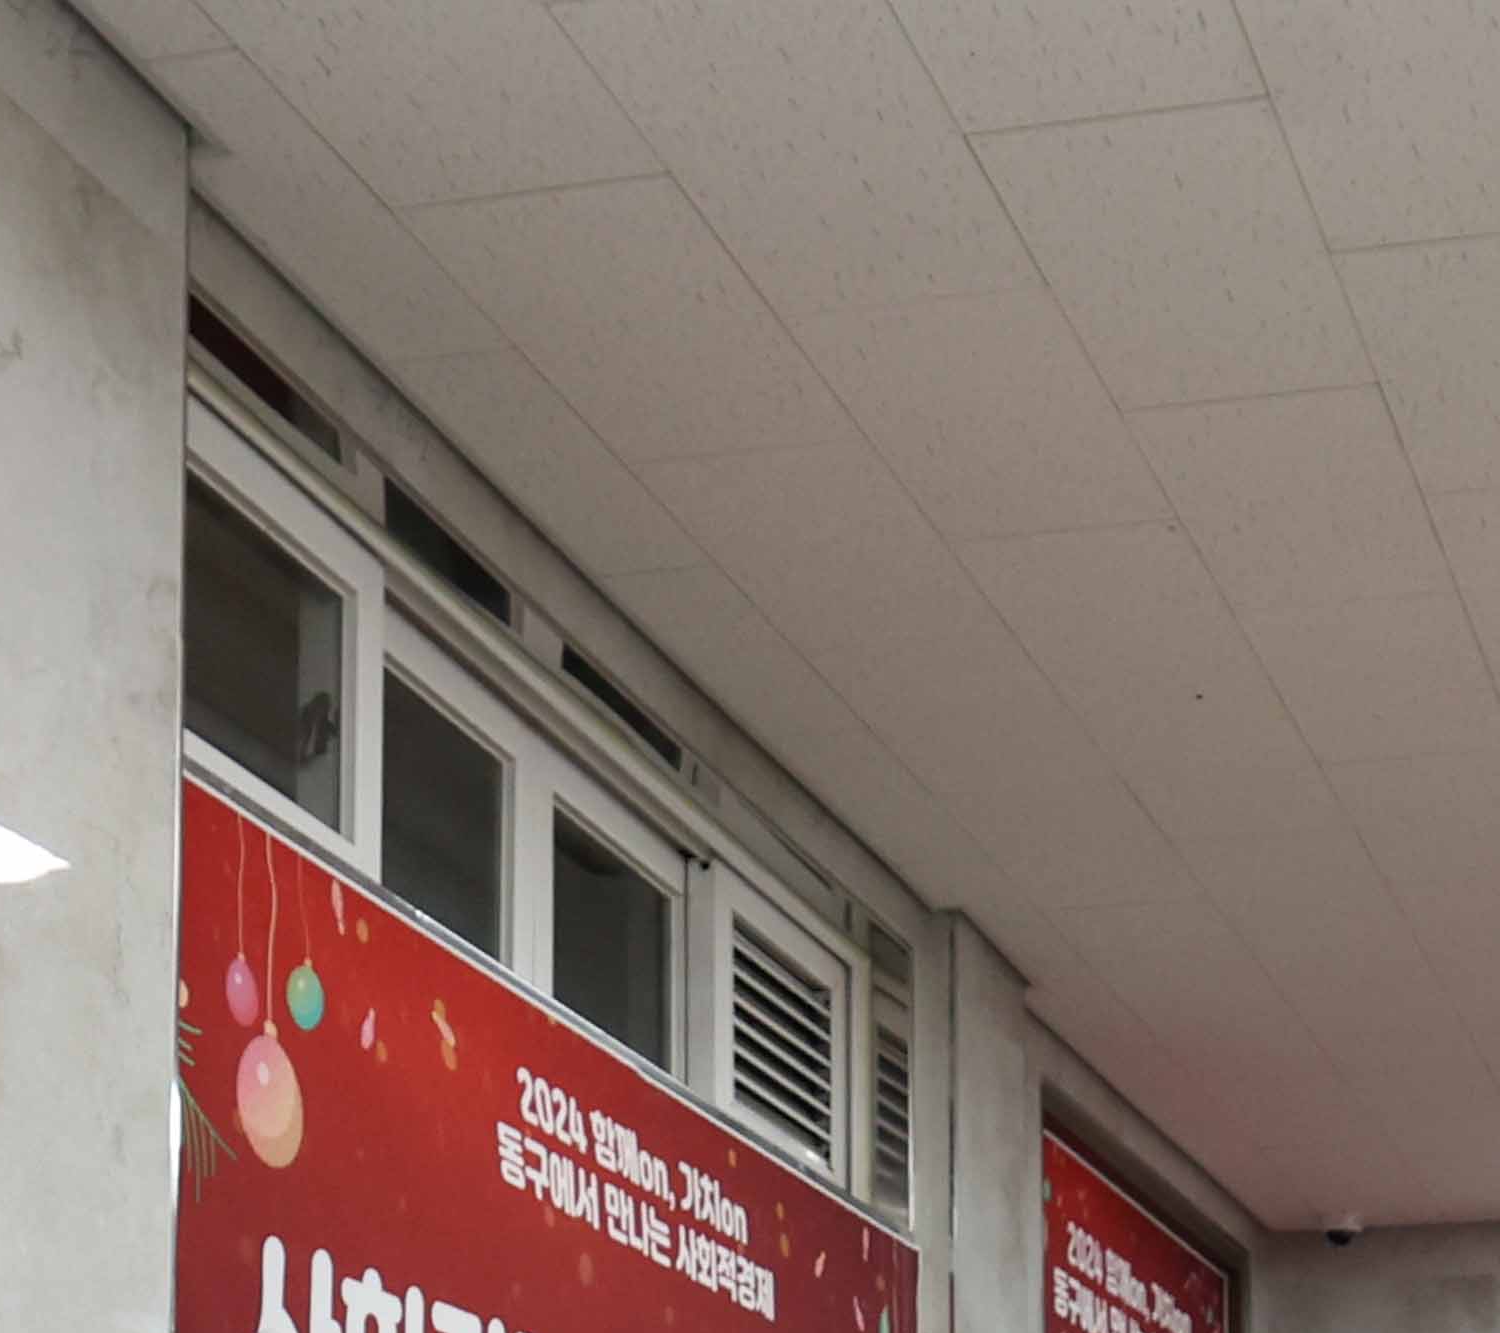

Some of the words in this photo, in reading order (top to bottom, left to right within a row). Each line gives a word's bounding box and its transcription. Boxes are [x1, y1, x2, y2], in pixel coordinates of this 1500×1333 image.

[496, 1121, 601, 1231] 동구에서
[603, 1182, 673, 1268] 만나는
[675, 1224, 776, 1322] 사회적경제
[516, 1066, 588, 1154] 2024
[589, 1110, 676, 1212] 함께on,
[677, 1160, 749, 1245] 가치on
